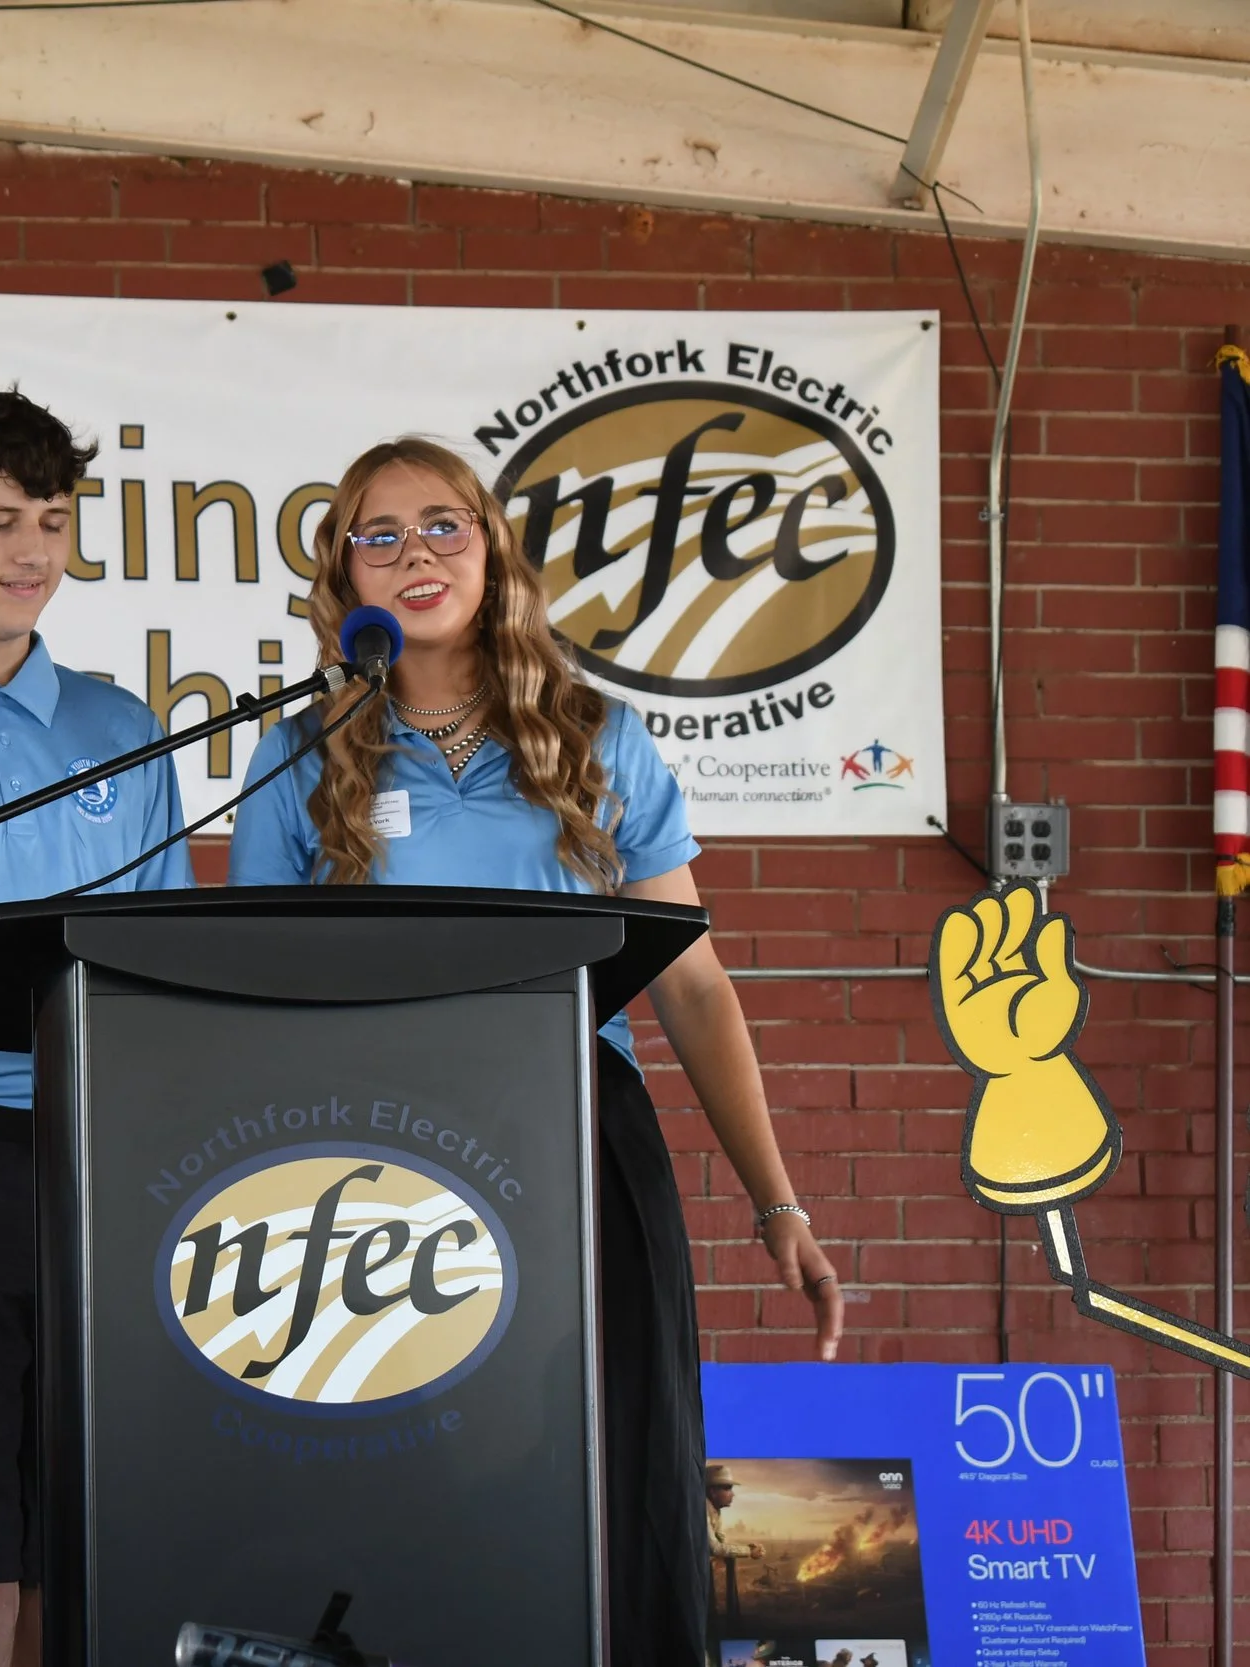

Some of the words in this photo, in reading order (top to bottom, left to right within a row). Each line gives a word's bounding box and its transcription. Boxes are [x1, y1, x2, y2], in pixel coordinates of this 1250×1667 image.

[473, 339, 706, 458] Northfork
[726, 341, 895, 457] Electric
[513, 411, 850, 650] nfec
[646, 680, 836, 741] perative
[70, 759, 90, 771] YOUTH
[696, 754, 831, 783] Cooperative
[691, 786, 739, 802] human
[146, 1096, 354, 1206] Northfork
[370, 1099, 525, 1203] Electric
[180, 1164, 481, 1380] nfec
[211, 1404, 466, 1465] Cooperative
[1090, 1459, 1119, 1468] CLASS
[964, 1519, 1004, 1545] 4K
[1007, 1519, 1074, 1545] UHD
[967, 1553, 1051, 1580] Smart
[1053, 1553, 1097, 1580] TV
[1020, 1636, 1050, 1644] Account
[1034, 1624, 1046, 1633] TV
